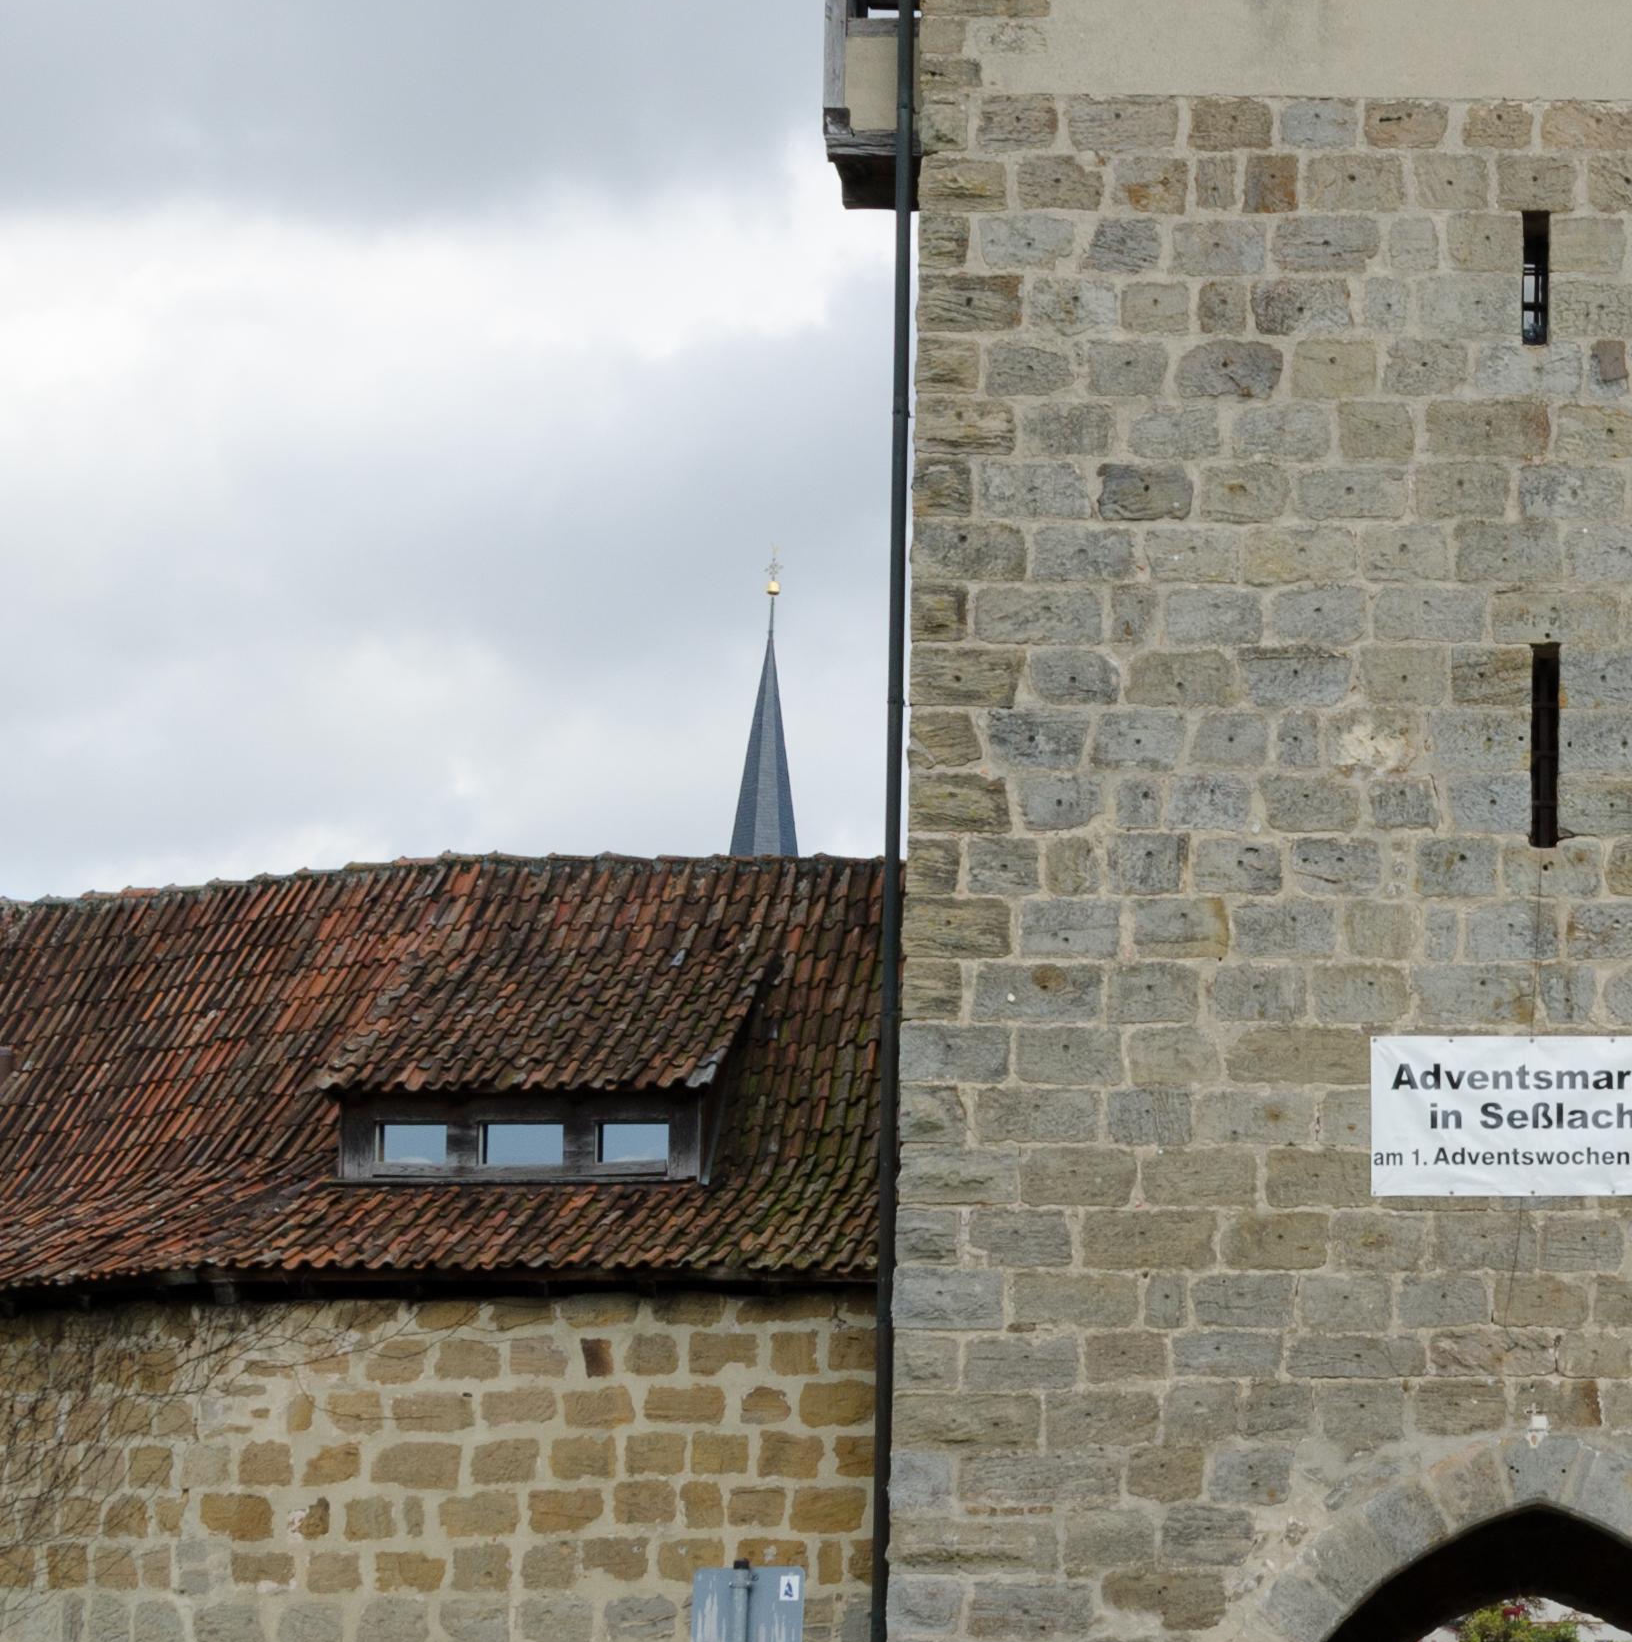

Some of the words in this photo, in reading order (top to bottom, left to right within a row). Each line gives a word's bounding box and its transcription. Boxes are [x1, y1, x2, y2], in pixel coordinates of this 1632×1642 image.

[1430, 1103, 1462, 1129] in
[1373, 1151, 1403, 1166] am
[1411, 1149, 1428, 1166] 1.
